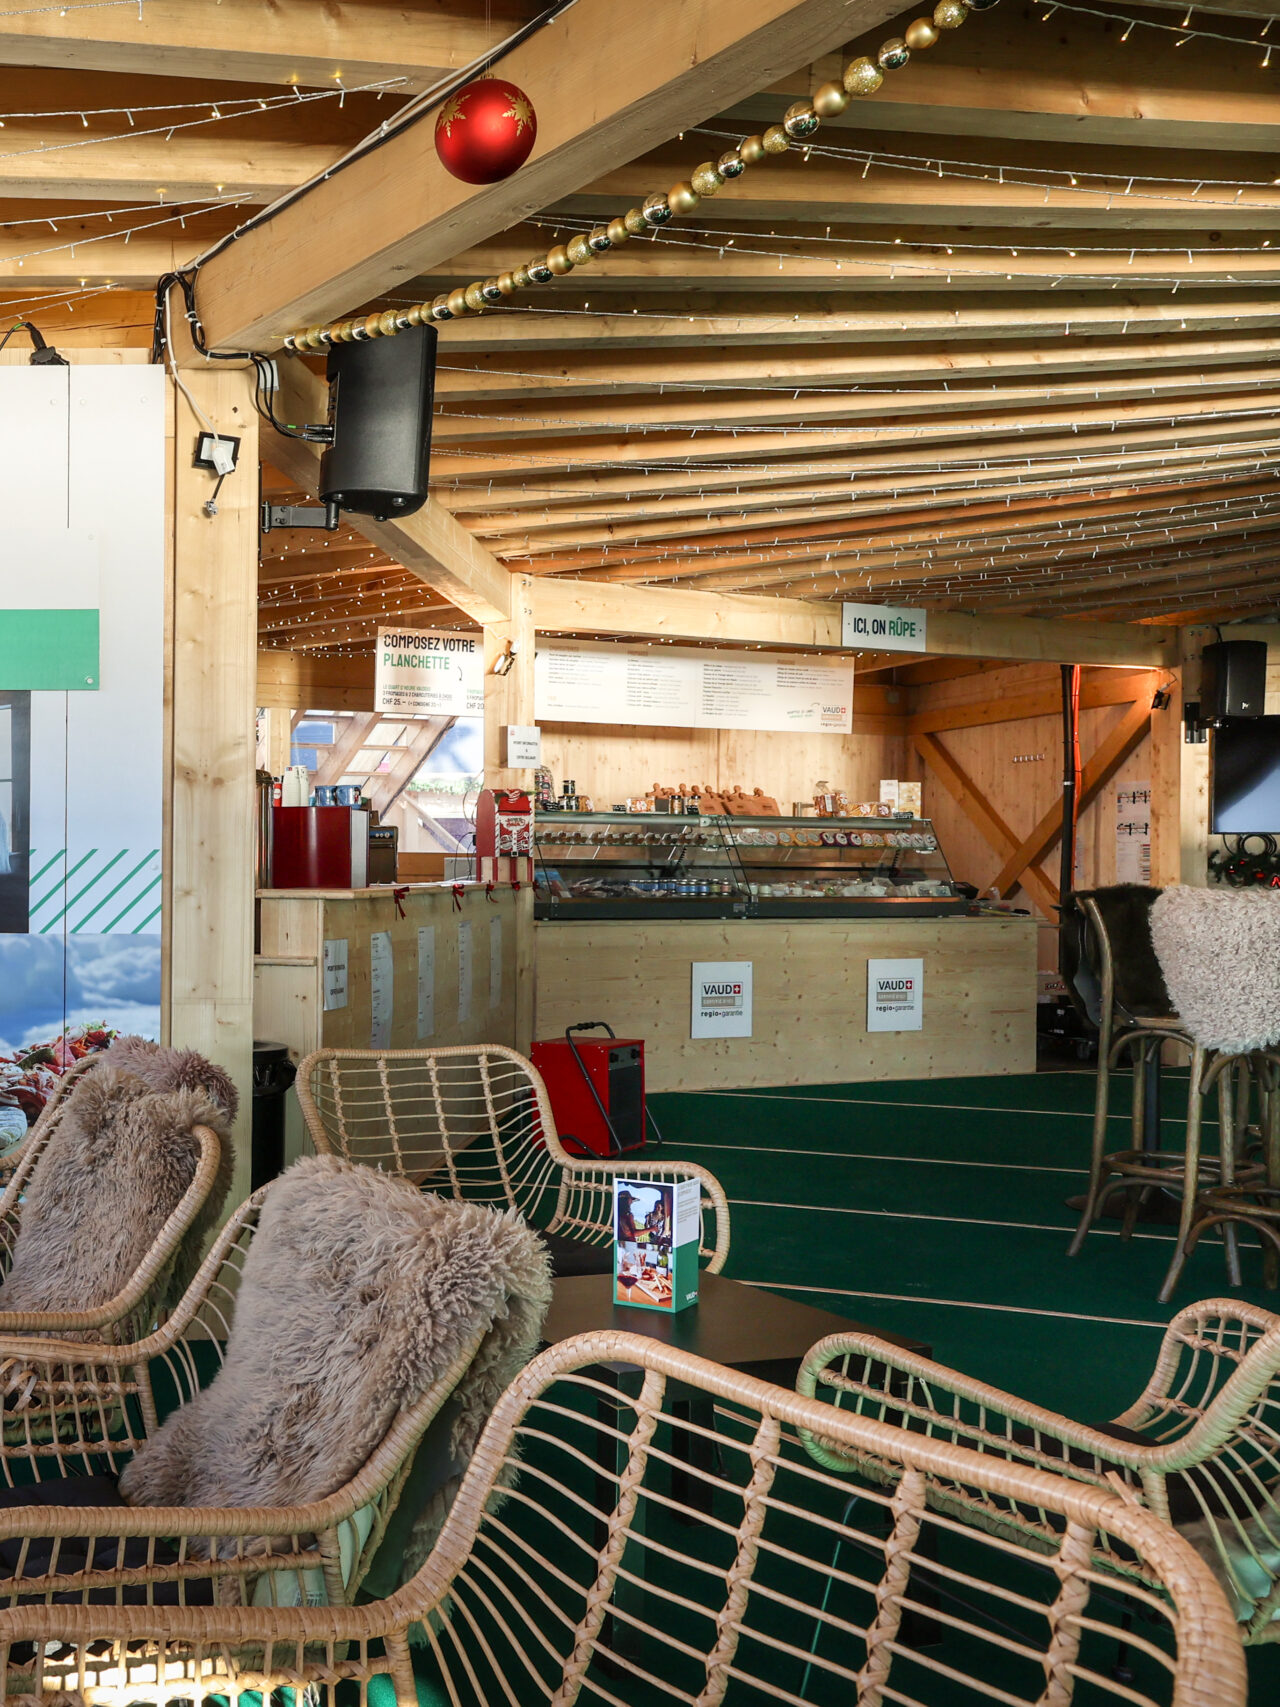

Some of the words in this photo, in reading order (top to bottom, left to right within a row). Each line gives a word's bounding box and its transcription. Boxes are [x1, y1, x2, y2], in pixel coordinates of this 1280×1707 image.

[853, 617, 870, 637] ICI,
[872, 618, 886, 635] ON
[888, 616, 917, 638] RÛPE
[384, 634, 441, 651] COMPOSEZ
[442, 638, 475, 653] VOTRE
[383, 653, 450, 670] PLANCHETTE
[822, 706, 840, 714] VAUD
[703, 984, 733, 995] VAUD
[878, 980, 905, 991] VAUD
